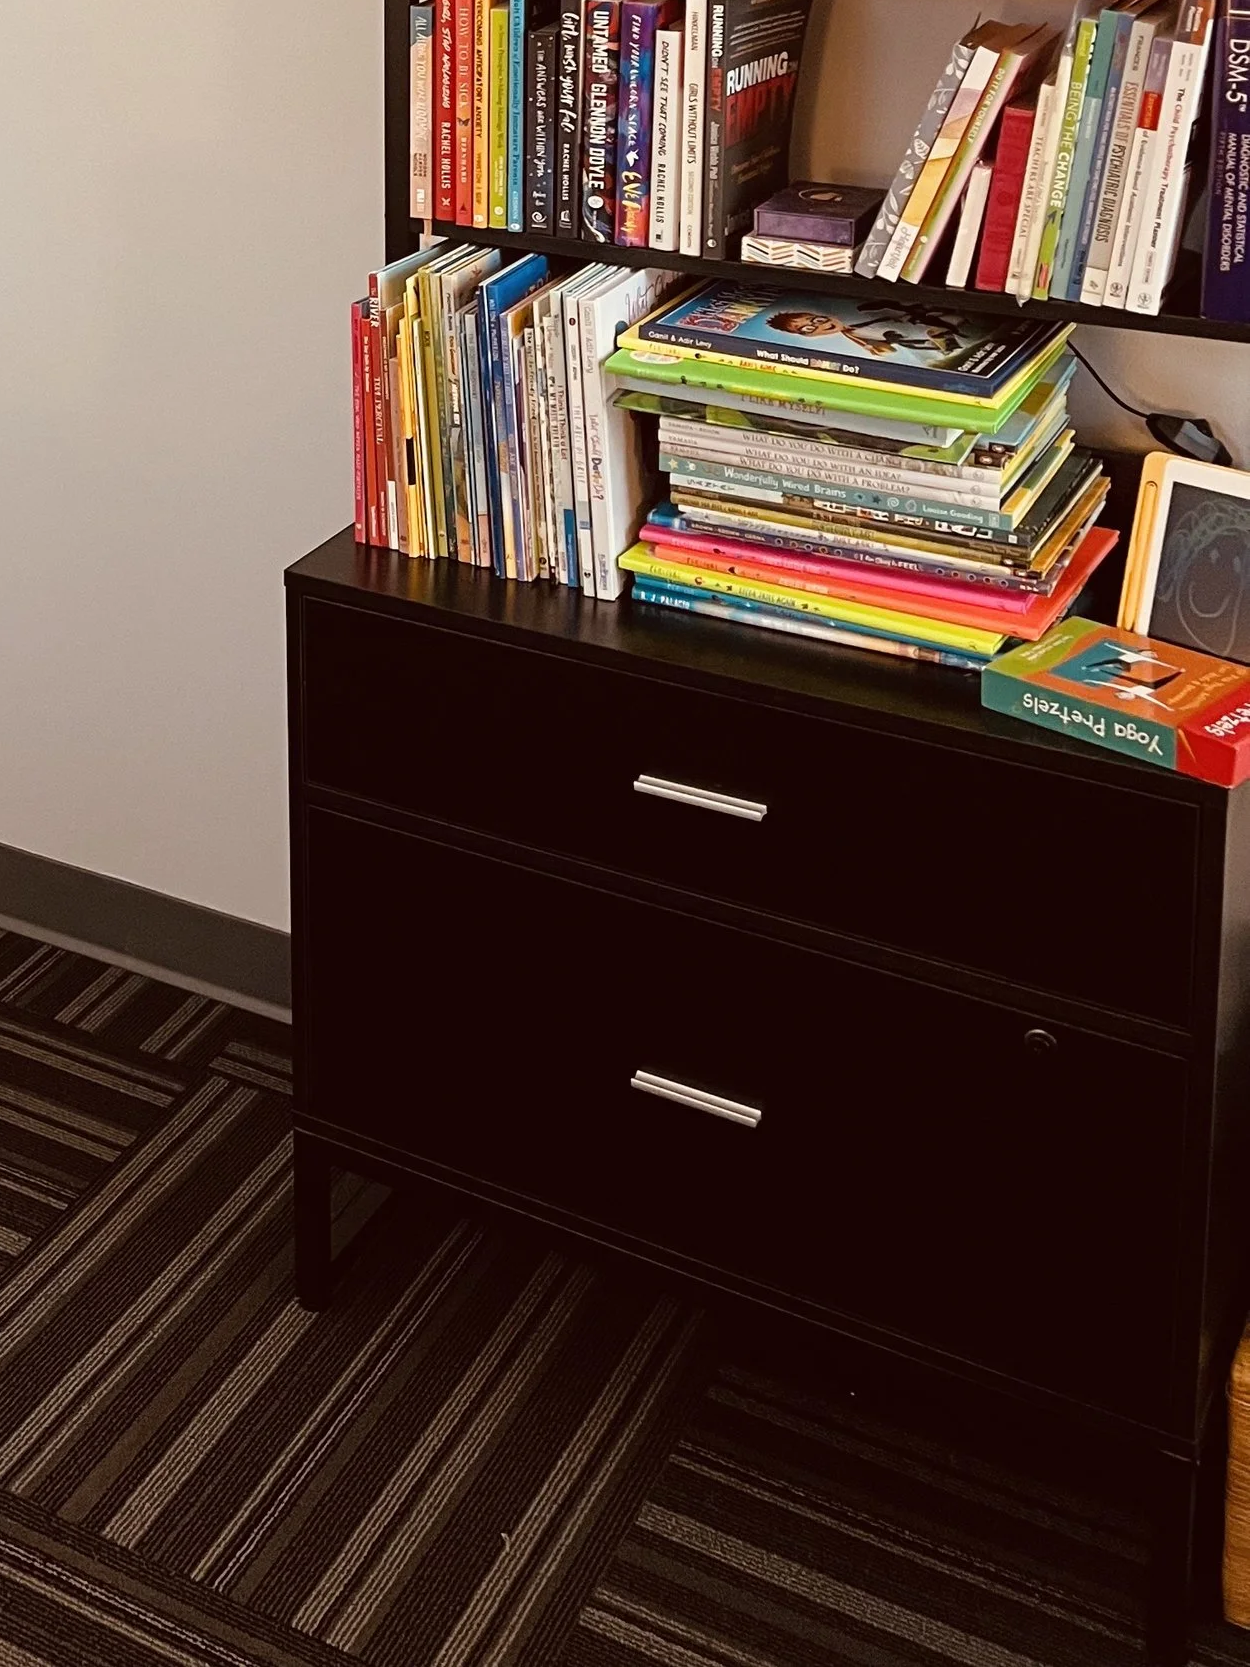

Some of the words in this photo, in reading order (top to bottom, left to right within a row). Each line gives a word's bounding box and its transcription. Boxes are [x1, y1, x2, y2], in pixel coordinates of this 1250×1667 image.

[415, 15, 428, 31] ALL
[459, 7, 469, 37] HOW
[512, 16, 522, 53] Children
[561, 12, 580, 41] Girl,
[631, 14, 642, 40] FIND
[690, 11, 699, 51] HINKELMAN
[711, 4, 724, 58] RUNNING
[441, 27, 452, 51] STOP
[459, 44, 469, 60] TO
[591, 10, 611, 73] UNTAMED
[628, 41, 640, 67] YOUR
[1131, 35, 1145, 72] FRANCES
[416, 60, 427, 79] YOU
[459, 65, 469, 76] BE
[562, 44, 577, 73] wash
[661, 40, 670, 76] DIDN'T
[711, 57, 719, 69] ON
[726, 51, 789, 96] RUNNING
[994, 67, 1006, 81] DO
[441, 52, 452, 109] APOLOGIZING
[475, 48, 483, 103] ANTICIPATORY
[512, 61, 521, 110] Emotionally
[559, 75, 575, 107] your
[628, 69, 640, 110] UNICORN
[660, 76, 669, 93] SEE
[710, 68, 722, 112] EMPTY
[991, 81, 999, 90] IT
[459, 82, 468, 108] SICK
[659, 96, 668, 121] THAT
[688, 82, 699, 103] GIRLS
[984, 89, 996, 105] FOR
[1065, 81, 1083, 121] BEING
[1116, 81, 1139, 130] ESSENTIALS
[1176, 87, 1186, 102] The
[559, 109, 578, 133] face
[589, 83, 608, 145] GLENNON
[627, 113, 638, 147] SPACE
[687, 104, 698, 139] WITHOUT
[967, 105, 989, 144] YOURSELF
[1172, 104, 1183, 124] Child
[441, 121, 451, 155] RACHEL
[512, 111, 521, 152] Immature
[657, 122, 667, 157] COMING
[1061, 124, 1075, 150] THE
[1114, 130, 1130, 143] OF
[562, 143, 570, 172] RACHEL
[687, 140, 697, 164] LIMITS
[1028, 136, 1044, 182] TEACHERS
[1160, 126, 1179, 182] Psychotherapy
[1225, 132, 1237, 170] MANUAL
[1238, 133, 1250, 191] DIAGNOSTIC
[441, 158, 451, 189] HOLLIS
[512, 154, 520, 186] Parents
[588, 147, 606, 190] DOYLE
[655, 163, 666, 193] RACHEL
[1049, 151, 1072, 209] CHANGE
[1103, 143, 1126, 197] PSYCHIATRIC
[1225, 172, 1236, 186] OF
[561, 174, 570, 201] HOLLIS
[621, 171, 643, 199] EVE
[1025, 185, 1036, 201] ARE
[1154, 182, 1169, 220] Treatment
[655, 195, 665, 224] HOLLIS
[1222, 187, 1234, 221] MENTAL
[1236, 191, 1248, 213] AND
[1018, 203, 1032, 239] SPECIAL
[1095, 197, 1118, 243] DIAGNOSIS
[1149, 221, 1162, 249] Planner
[884, 225, 912, 270] Heartfelt
[1219, 223, 1232, 272] DISORDERS
[1233, 214, 1248, 264] STATISTICAL
[368, 296, 380, 329] RIVER
[670, 334, 677, 342] &
[678, 336, 694, 346] Adir
[695, 339, 712, 349] Levy
[756, 349, 779, 361] What
[780, 353, 809, 366] Should
[842, 364, 860, 375] Do?
[374, 397, 384, 445] PERCIVAL
[667, 435, 698, 446] YAMADA
[739, 456, 766, 469] WHAT
[768, 460, 783, 471] DO
[785, 464, 805, 475] YOU
[807, 468, 822, 479] DO
[824, 471, 851, 484] WITH
[853, 477, 859, 485] A
[861, 478, 910, 494] PROBLEM?
[745, 448, 772, 460] WHAT
[774, 451, 789, 462] DO
[790, 454, 810, 465] YOU
[813, 458, 828, 468] DO
[829, 461, 856, 474] WITH
[858, 467, 872, 477] AN
[874, 470, 901, 480] IDEA?
[723, 465, 779, 489] Wonderfully
[782, 477, 811, 493] Wired
[814, 484, 847, 499] Brains
[922, 504, 948, 516] Louise
[950, 508, 983, 524] Gooding
[1021, 692, 1107, 738] Pretzels
[1113, 722, 1164, 757] Yoga
